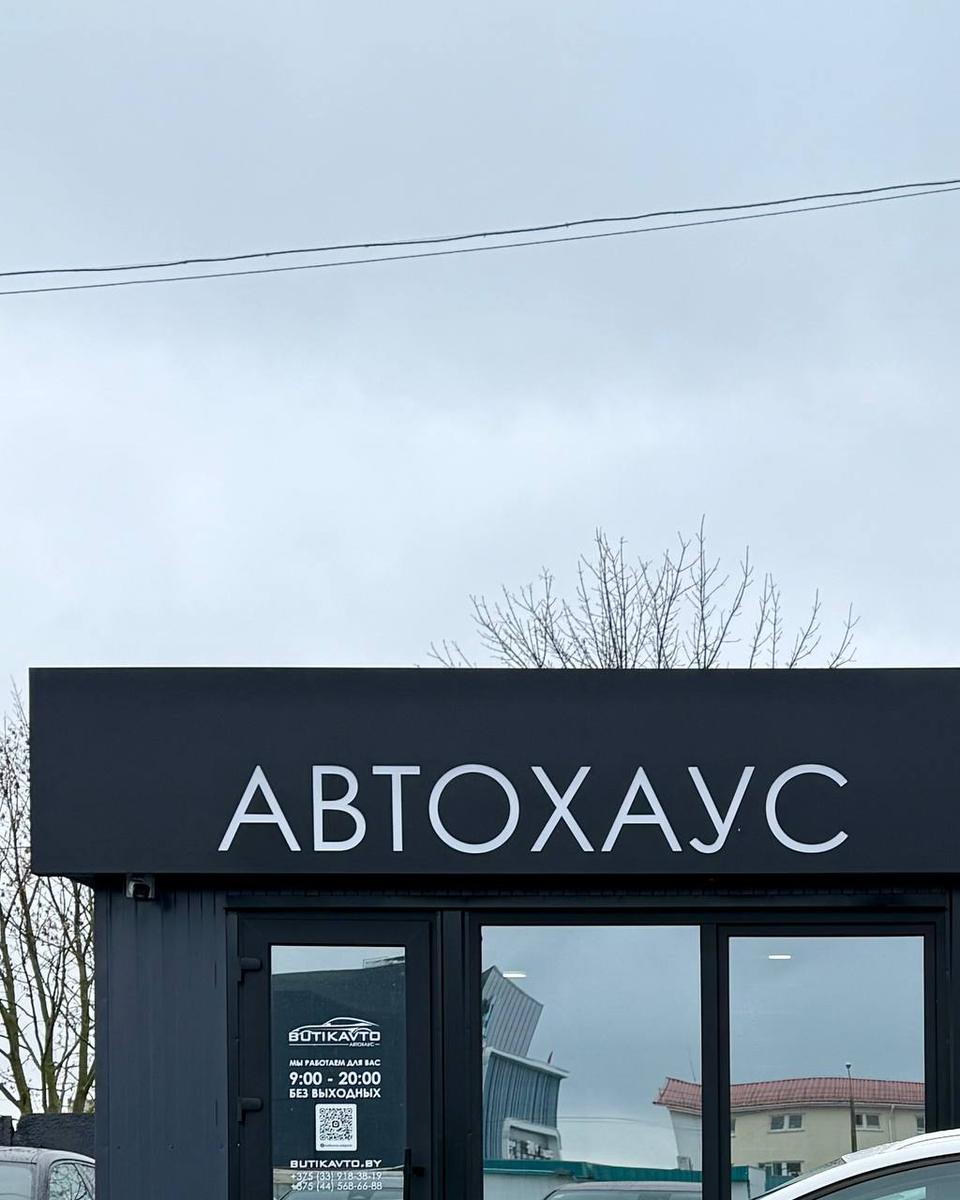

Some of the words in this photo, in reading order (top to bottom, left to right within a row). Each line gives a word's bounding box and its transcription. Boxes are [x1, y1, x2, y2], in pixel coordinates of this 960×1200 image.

[217, 763, 849, 855] АВТОХАУС
[288, 1031, 381, 1042] BUTIKAVTO
[289, 1059, 303, 1067] МЫ
[304, 1059, 346, 1067] РАБОТАЕМ
[346, 1059, 363, 1067] ДЛЯ
[364, 1059, 381, 1067] ВАС
[289, 1071, 323, 1086] 9:00
[338, 1071, 382, 1086] 20:00
[289, 1088, 309, 1099] БЕЗ
[311, 1088, 382, 1099] ВЫХОДНЫХ
[290, 1160, 382, 1169] BUTIKAVTO.BY
[291, 1171, 314, 1180] +375
[316, 1171, 334, 1182] (33)
[337, 1171, 383, 1180] 918-38-19
[316, 1181, 334, 1192] (44)
[337, 1181, 383, 1191] 568-66-88
